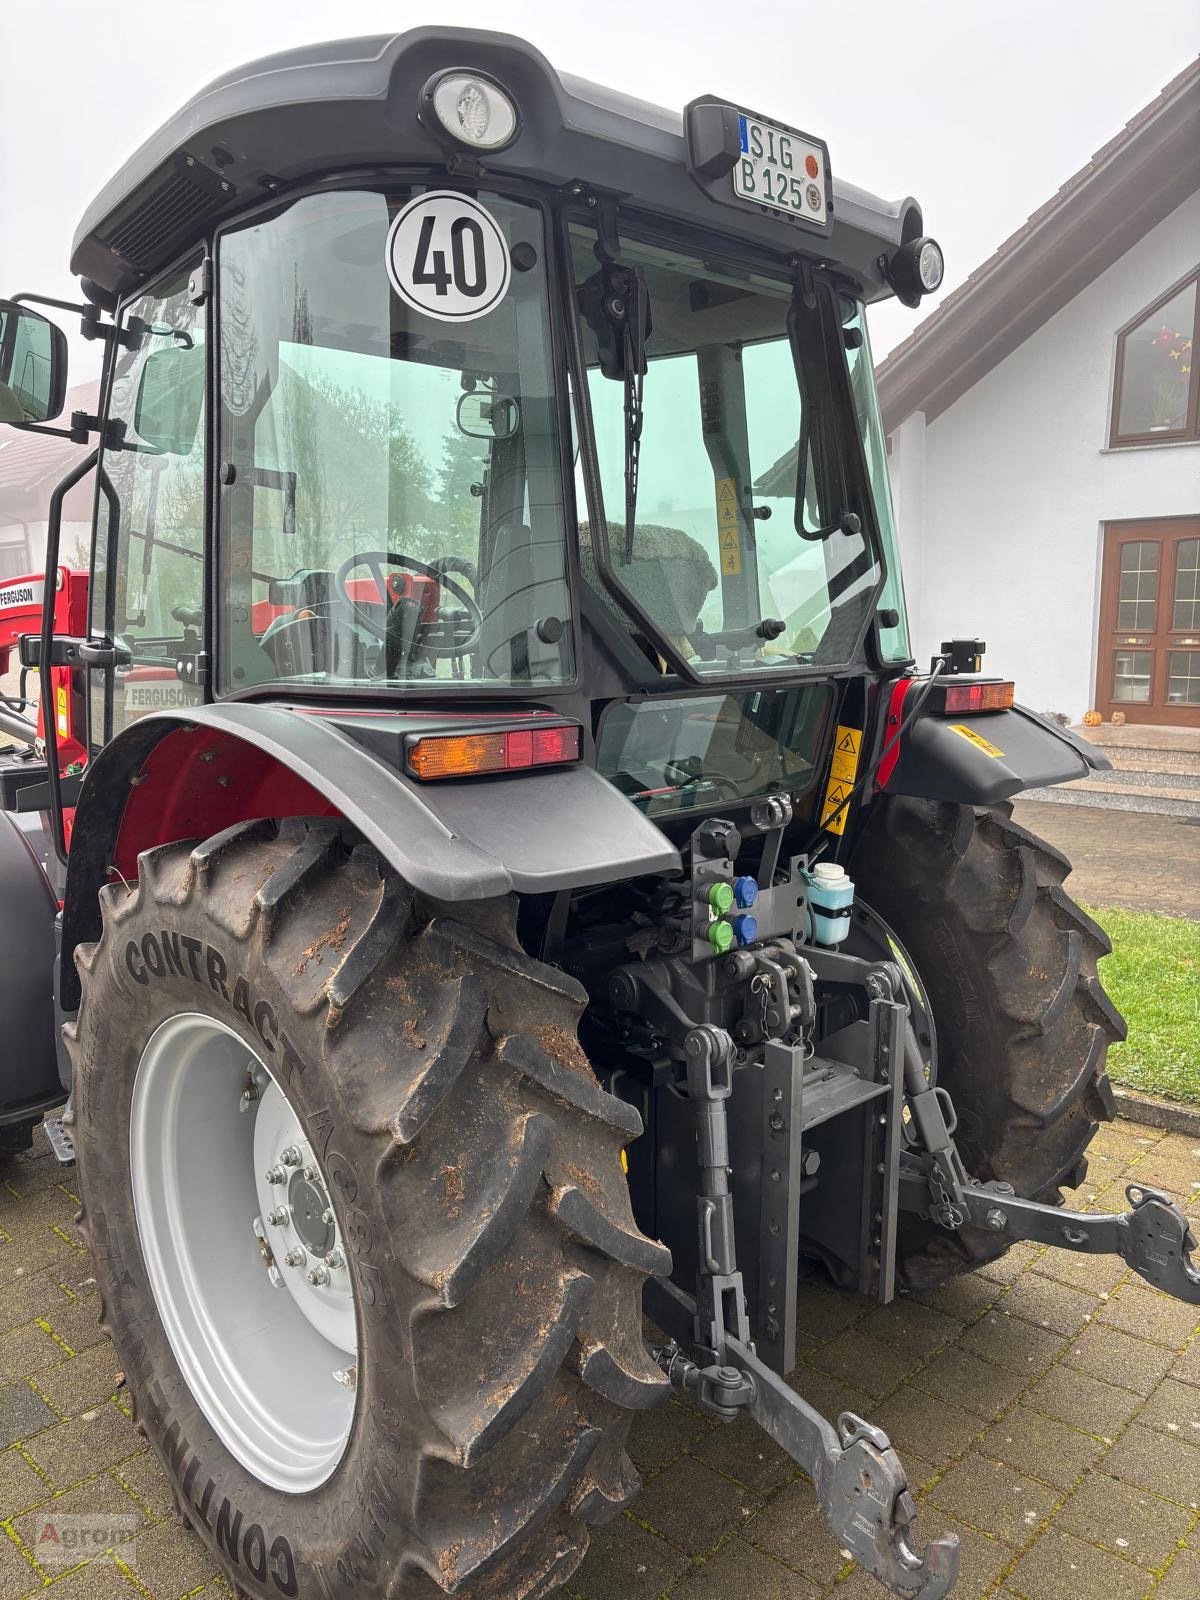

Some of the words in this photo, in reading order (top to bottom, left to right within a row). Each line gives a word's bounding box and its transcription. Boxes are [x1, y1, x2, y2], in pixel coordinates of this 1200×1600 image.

[750, 125, 793, 171] SIG
[742, 158, 756, 194] B
[763, 168, 802, 210] 125
[412, 216, 487, 298] 40
[0, 588, 33, 606] FERGUSON
[125, 930, 306, 1100] CONTRACT
